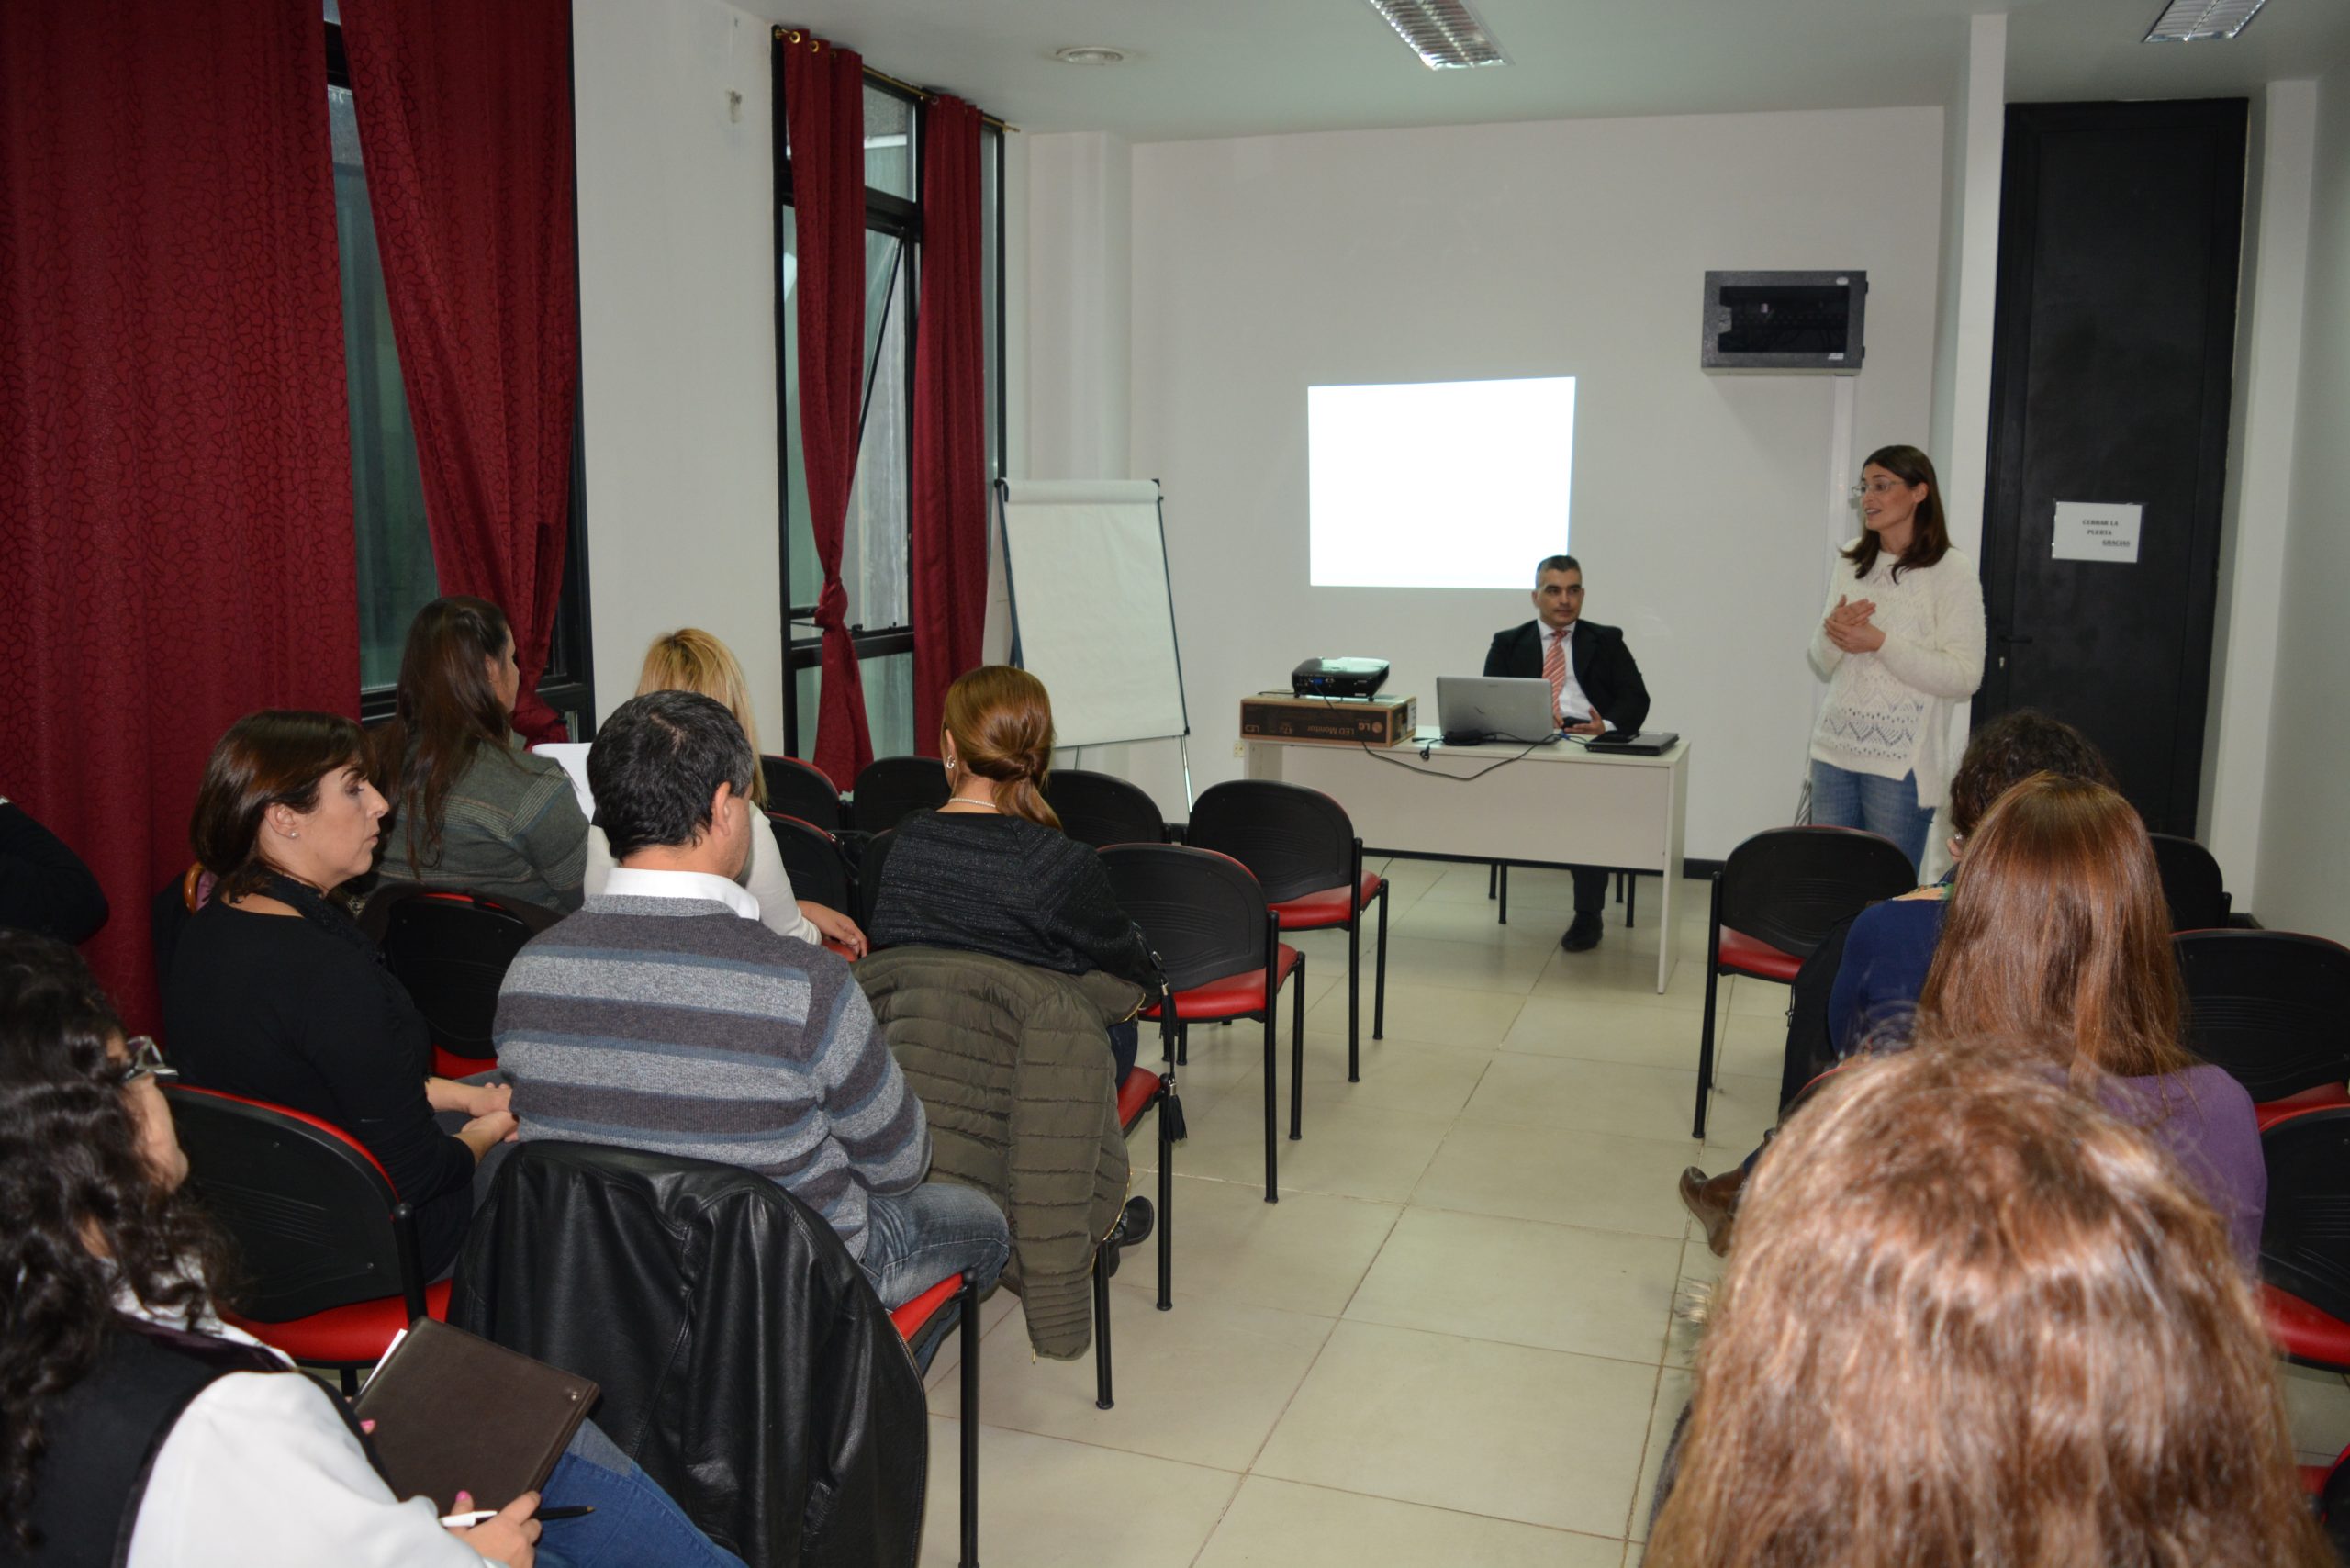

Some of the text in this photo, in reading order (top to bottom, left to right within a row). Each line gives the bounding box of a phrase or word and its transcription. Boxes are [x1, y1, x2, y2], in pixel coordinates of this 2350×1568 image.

[1307, 725, 1355, 735] LED Monitor
[1359, 722, 1371, 731] LG
